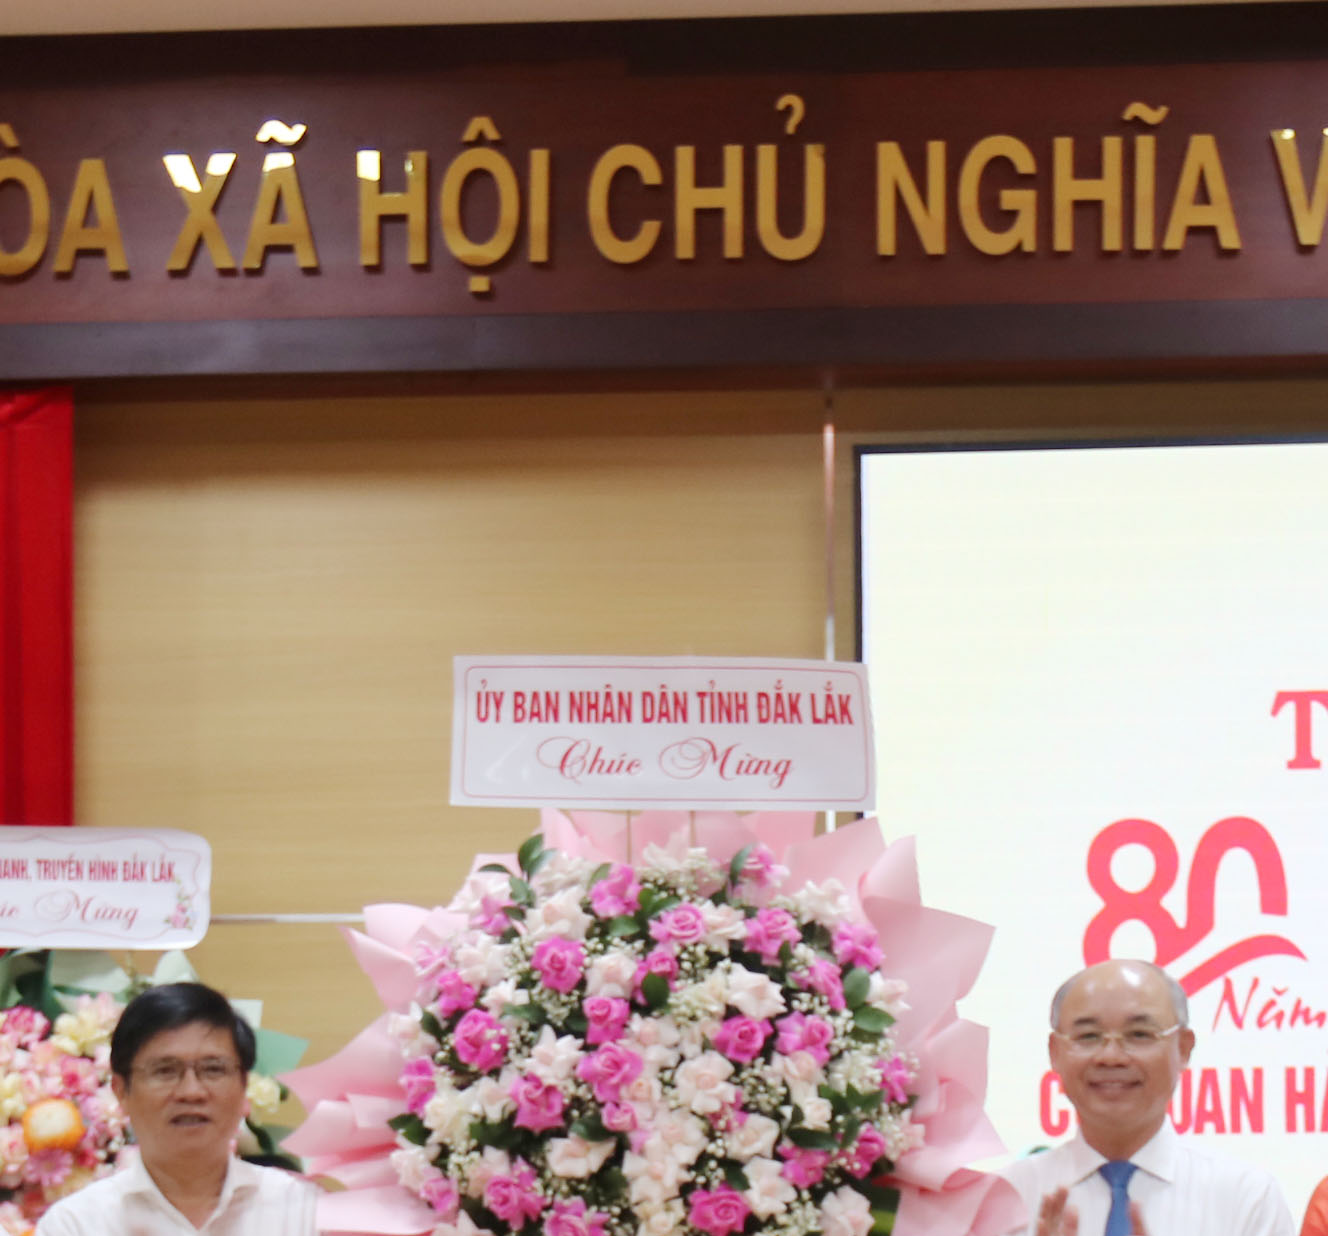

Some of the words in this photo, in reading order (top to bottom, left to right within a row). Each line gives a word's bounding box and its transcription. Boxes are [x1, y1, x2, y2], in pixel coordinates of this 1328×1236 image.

[162, 119, 319, 273] XÃ
[356, 116, 550, 292] HỘI
[587, 95, 826, 263] CHỦ
[876, 103, 1242, 256] NGHĨA
[475, 680, 505, 723] ỦY
[513, 690, 560, 724] BAN
[568, 684, 633, 724] NHÂN
[641, 684, 689, 725] DÂN
[696, 680, 749, 725] TỈNH
[757, 680, 803, 726] ĐẮK
[810, 681, 854, 726] LẮK
[536, 737, 642, 785] Chúc
[658, 737, 792, 789] Mừng
[1212, 976, 1328, 1032] Năm
[1168, 1067, 1265, 1135] UAN
